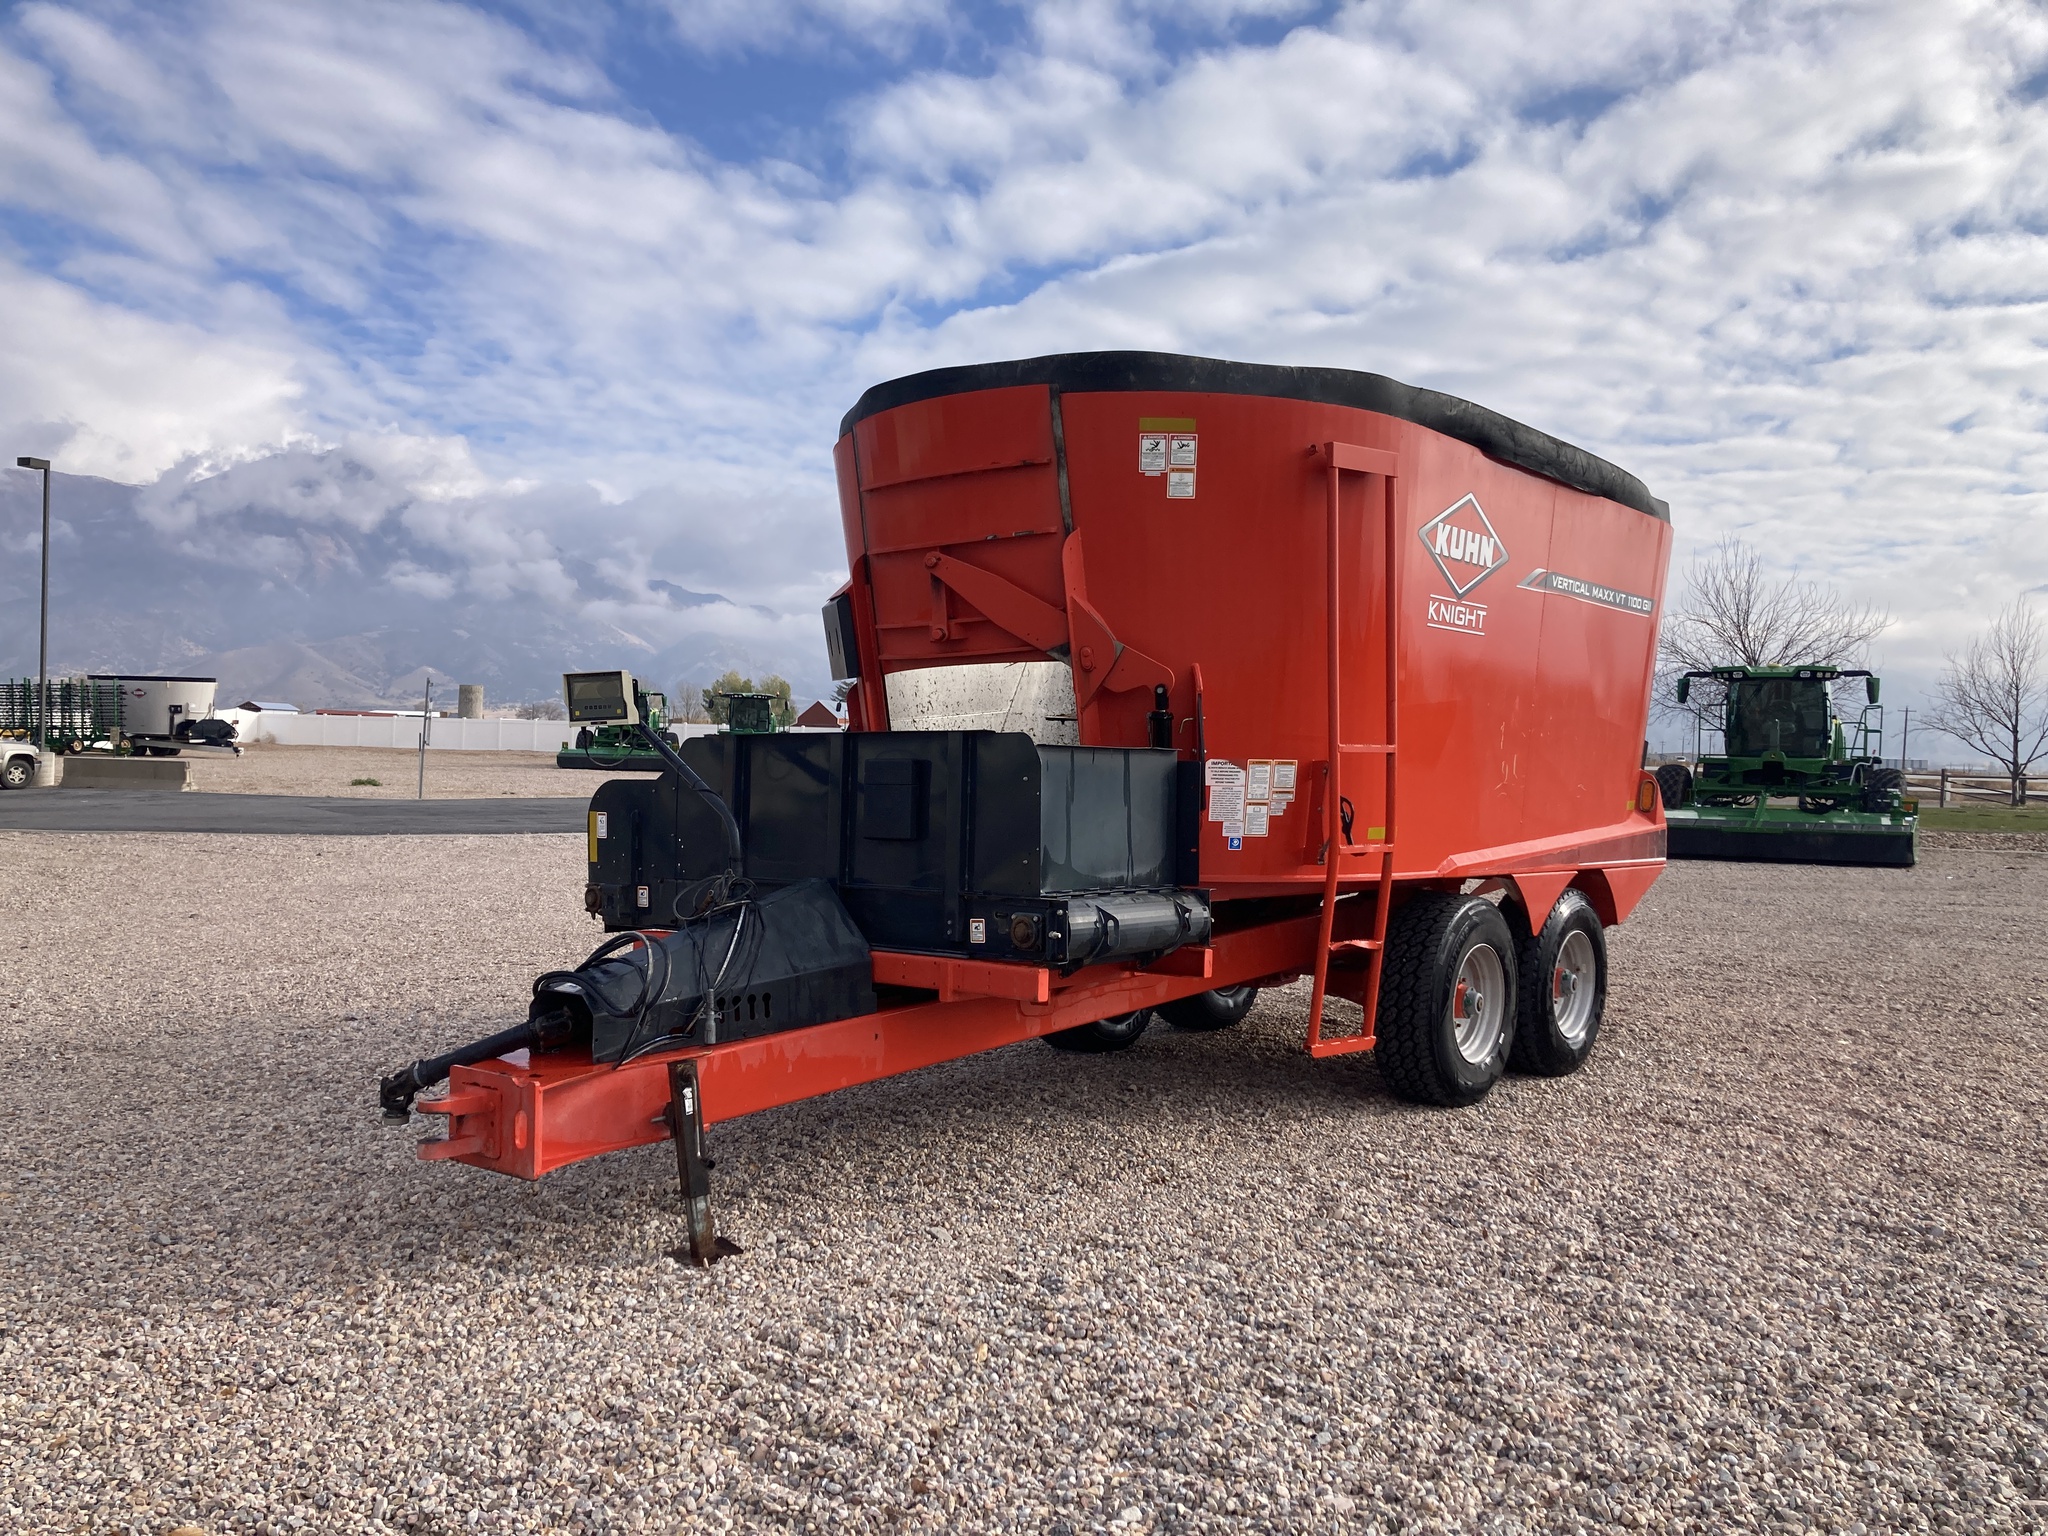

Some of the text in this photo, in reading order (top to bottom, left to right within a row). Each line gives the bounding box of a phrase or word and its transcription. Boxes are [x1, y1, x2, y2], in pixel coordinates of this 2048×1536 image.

[1435, 522, 1495, 568] KUHN
[1551, 574, 1590, 596] VERTICAL
[1591, 586, 1615, 603] MAXX
[1615, 592, 1627, 605] VT
[1627, 596, 1642, 609] 1100
[1428, 600, 1487, 629] KNIGHT
